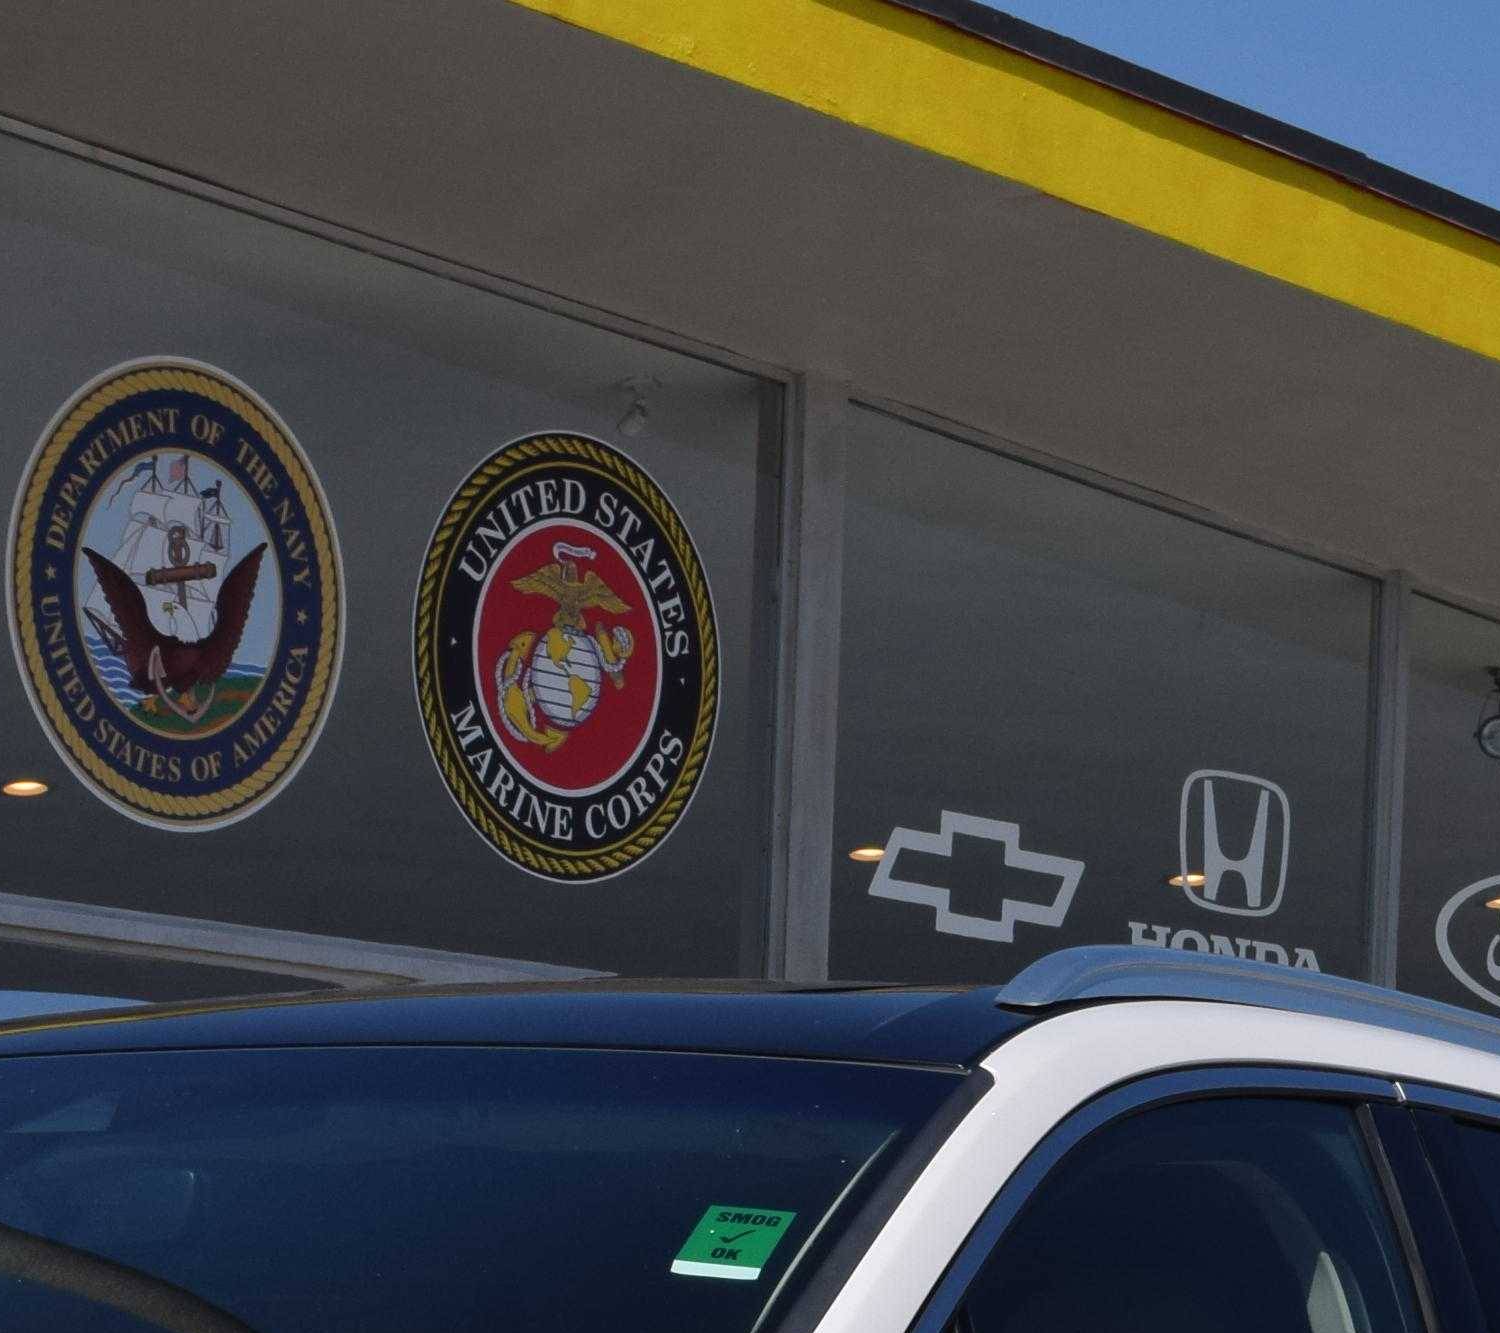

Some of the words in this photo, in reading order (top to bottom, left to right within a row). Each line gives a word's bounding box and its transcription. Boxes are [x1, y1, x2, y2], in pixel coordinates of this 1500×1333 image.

[46, 408, 180, 551] DEPARTMENT
[191, 414, 226, 447] OF
[234, 438, 279, 500] THE
[273, 497, 312, 588] NAVY
[458, 479, 586, 582] UNITED
[594, 492, 690, 658] STATES
[41, 595, 95, 721] UNITED
[94, 720, 181, 782] STATES
[191, 751, 222, 782] OF
[232, 647, 309, 768] AMERICA
[451, 701, 573, 841] MARINE
[585, 730, 684, 839] CORPS
[711, 1247, 742, 1260] OK
[716, 1211, 782, 1228] SMOG
